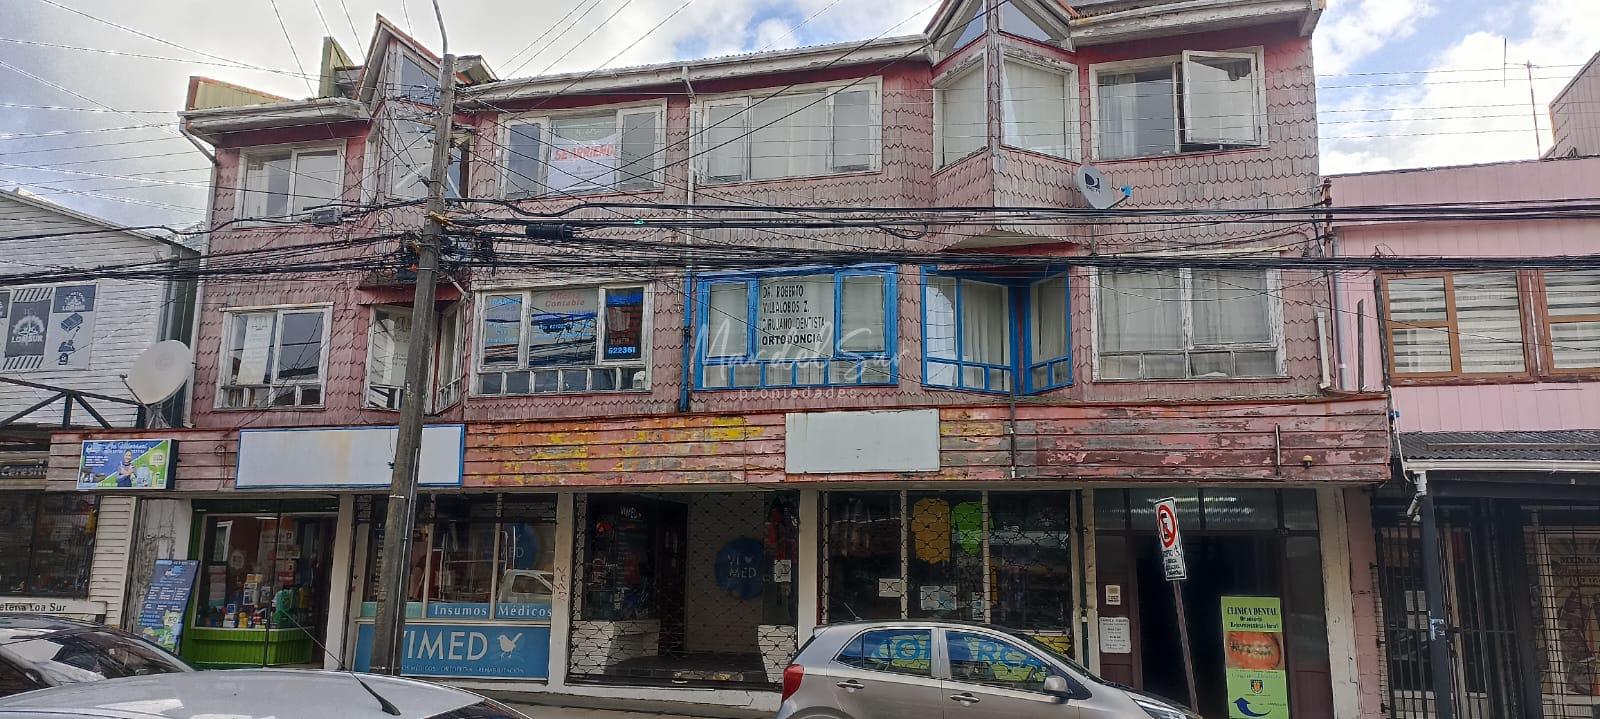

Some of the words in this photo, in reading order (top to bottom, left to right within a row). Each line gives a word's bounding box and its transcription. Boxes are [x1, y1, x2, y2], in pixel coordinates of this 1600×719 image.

[776, 284, 804, 298] ROBERTO
[545, 299, 585, 307] Contable
[762, 300, 800, 313] VILLALOBOS
[795, 316, 826, 330] DENTISTA
[761, 333, 823, 346] ORTODONCIA
[30, 602, 46, 611] Loa
[50, 602, 67, 612] Sur
[434, 605, 487, 616] Insumos
[498, 604, 552, 617] Médicos
[1253, 607, 1277, 616] DENTAL
[403, 629, 488, 661] IMED
